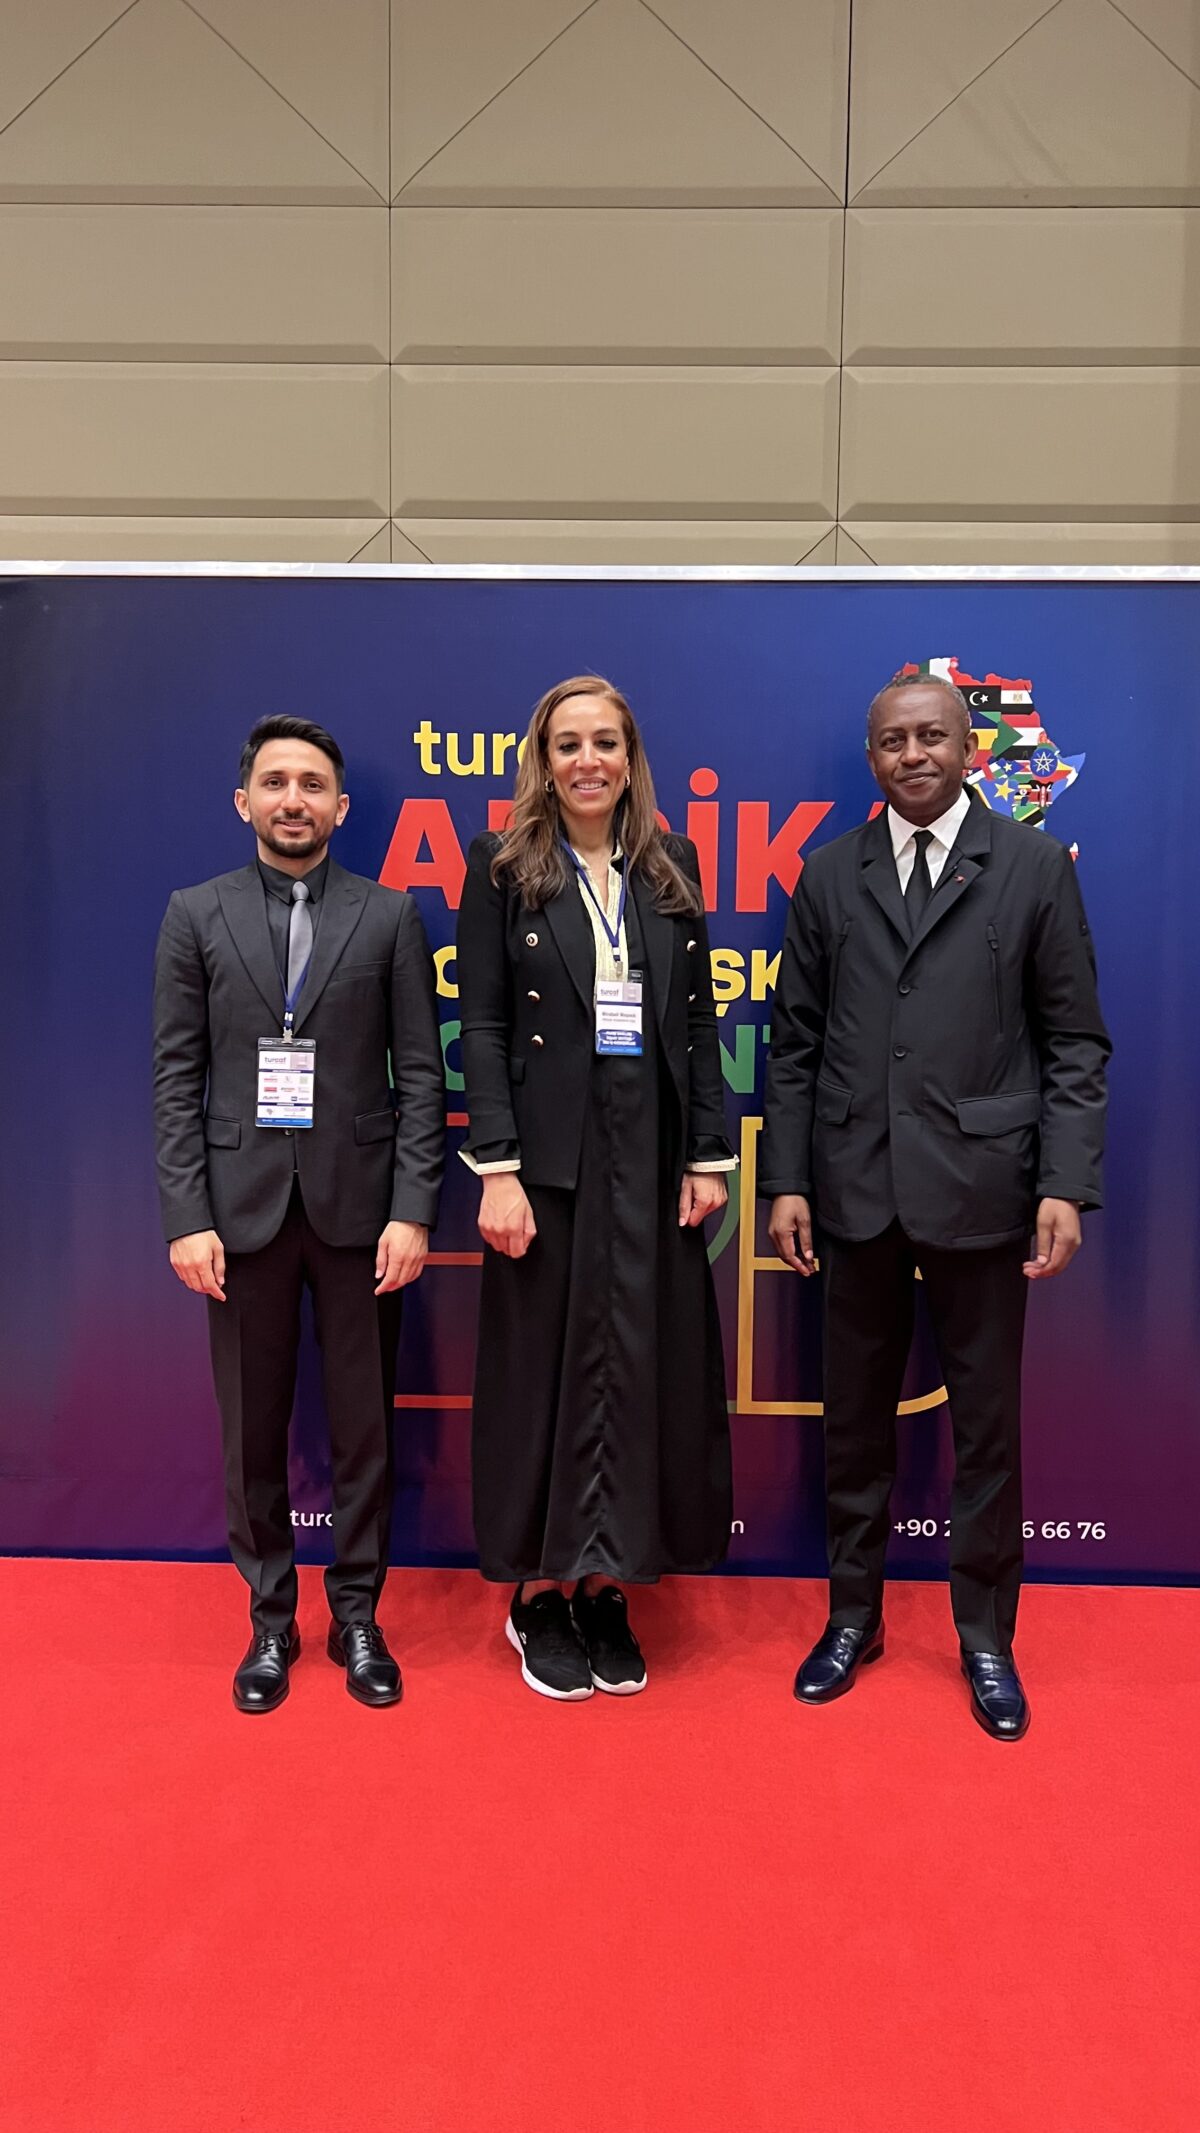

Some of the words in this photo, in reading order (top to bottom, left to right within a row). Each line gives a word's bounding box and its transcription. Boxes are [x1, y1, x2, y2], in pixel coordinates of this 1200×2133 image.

[413, 720, 529, 776] tur
[378, 767, 886, 912] AİK
[894, 1519, 937, 1537] +90
[1041, 1521, 1071, 1538] 66
[1077, 1522, 1106, 1539] 76
